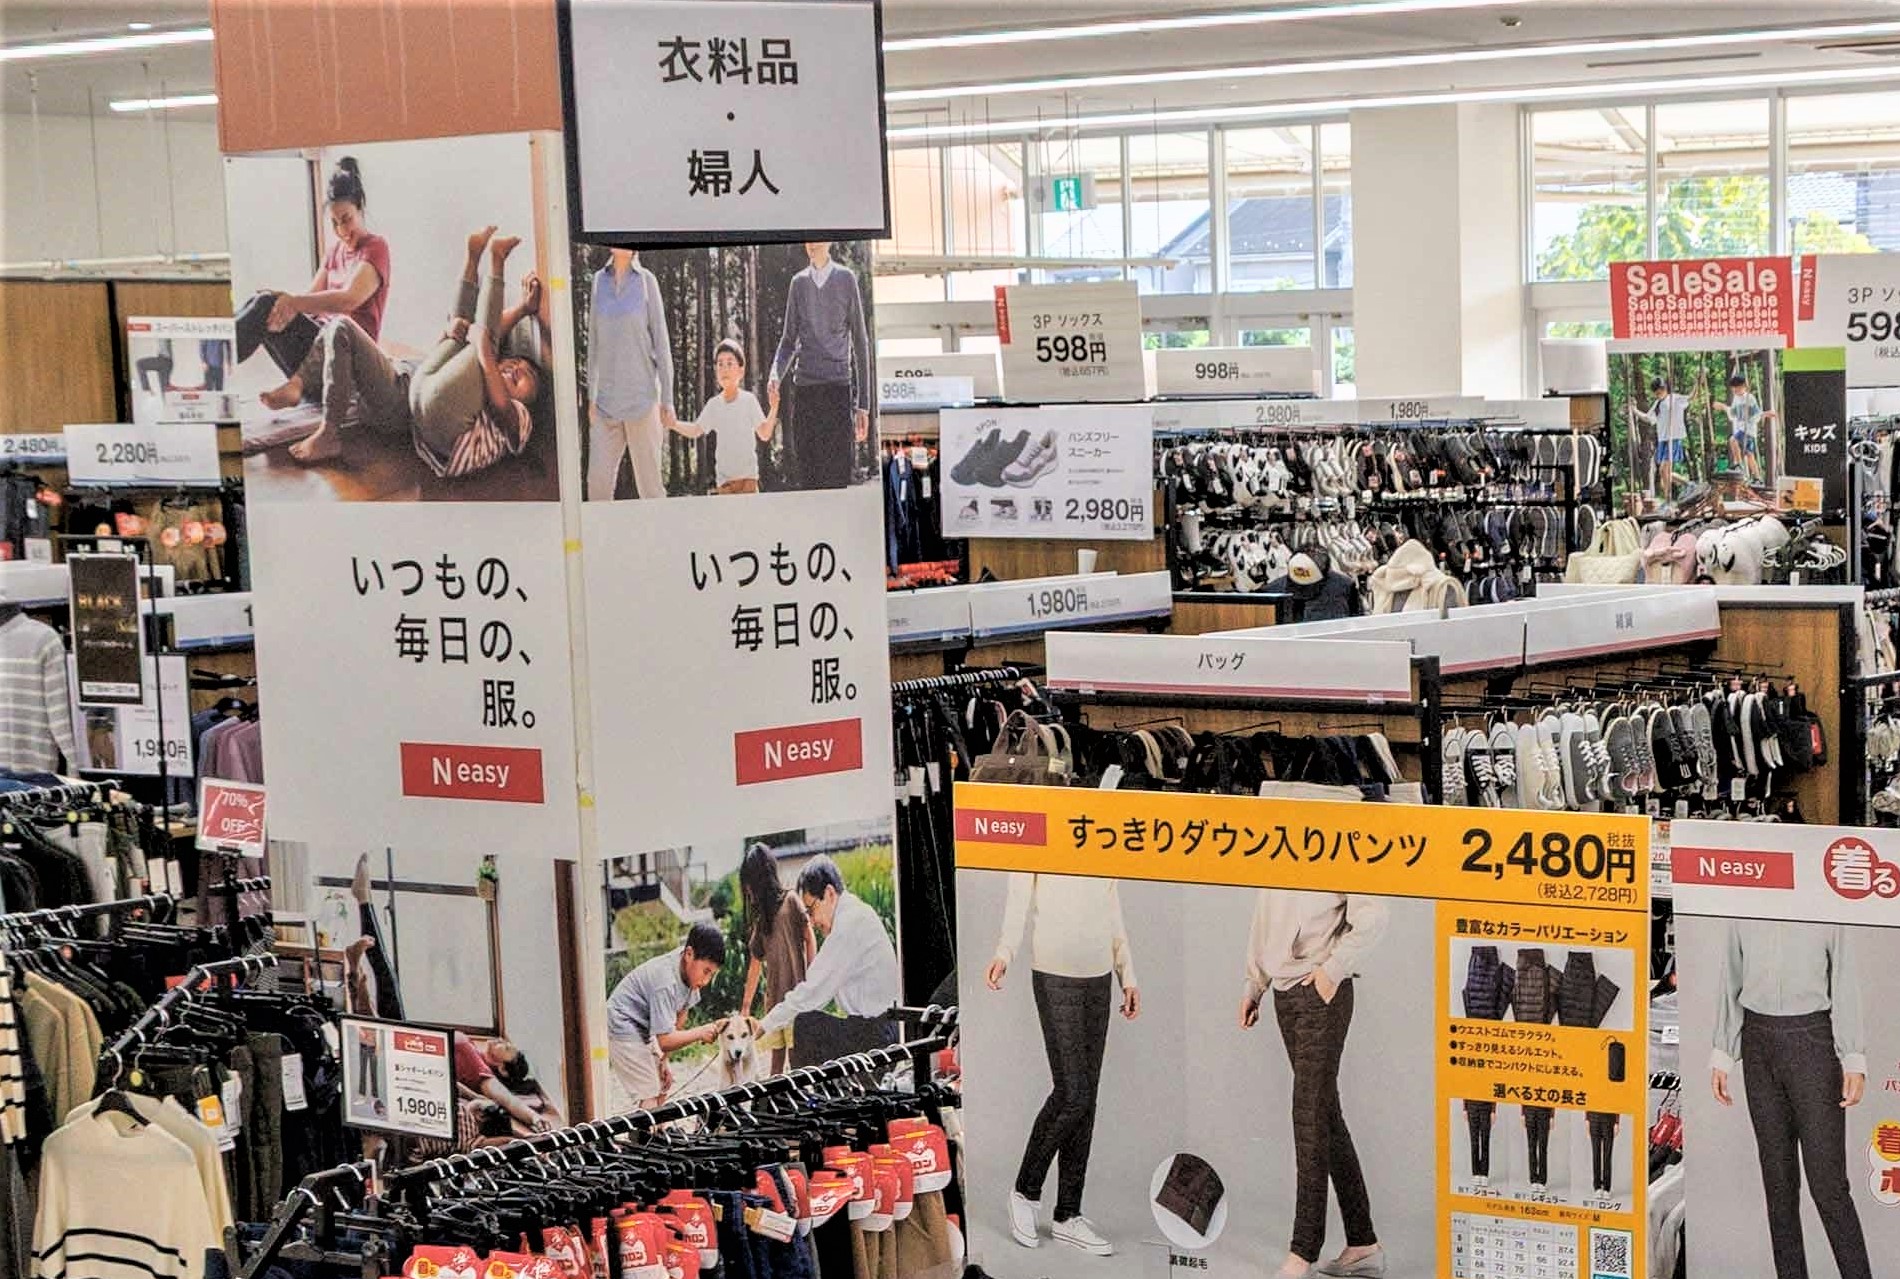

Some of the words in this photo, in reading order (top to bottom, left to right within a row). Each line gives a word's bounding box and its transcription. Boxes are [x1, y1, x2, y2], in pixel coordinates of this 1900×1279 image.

[658, 36, 798, 84] 衣料品
[687, 149, 780, 197] 婦人
[1849, 288, 1873, 303] 3P
[1033, 314, 1051, 329] 3P
[1058, 313, 1103, 328] ソックス
[1036, 335, 1107, 363] 598円
[1195, 363, 1239, 379] 998円
[1256, 404, 1301, 424] 2,980円
[1390, 401, 1429, 420] 1,980円
[1068, 432, 1120, 442] ハンズフリー
[1794, 423, 1836, 441] キッズ
[96, 443, 158, 465] 2,280円
[1068, 447, 1111, 457] スニーカー
[1804, 443, 1827, 453] KIDS
[1065, 498, 1144, 522] 2,980円
[690, 541, 852, 591] いつもの、
[351, 555, 529, 602] いつもの、
[1027, 587, 1088, 618] 1,980円
[731, 602, 856, 652] 毎日の、
[394, 613, 532, 666] 毎日の、
[1198, 652, 1246, 671] バッグ
[810, 656, 857, 704] 服。
[482, 678, 536, 729] 服。
[1068, 814, 1428, 868] すっきりダウン入りパンツ
[1607, 831, 1636, 849] 税抜
[1461, 826, 1635, 884] 2,480円
[1535, 881, 1639, 906] (税込2,728円)
[1456, 918, 1628, 944] 豊富なカラーバリエーション
[1493, 1083, 1587, 1106] 選べる丈の長さ
[397, 1097, 447, 1119] 1,980円
